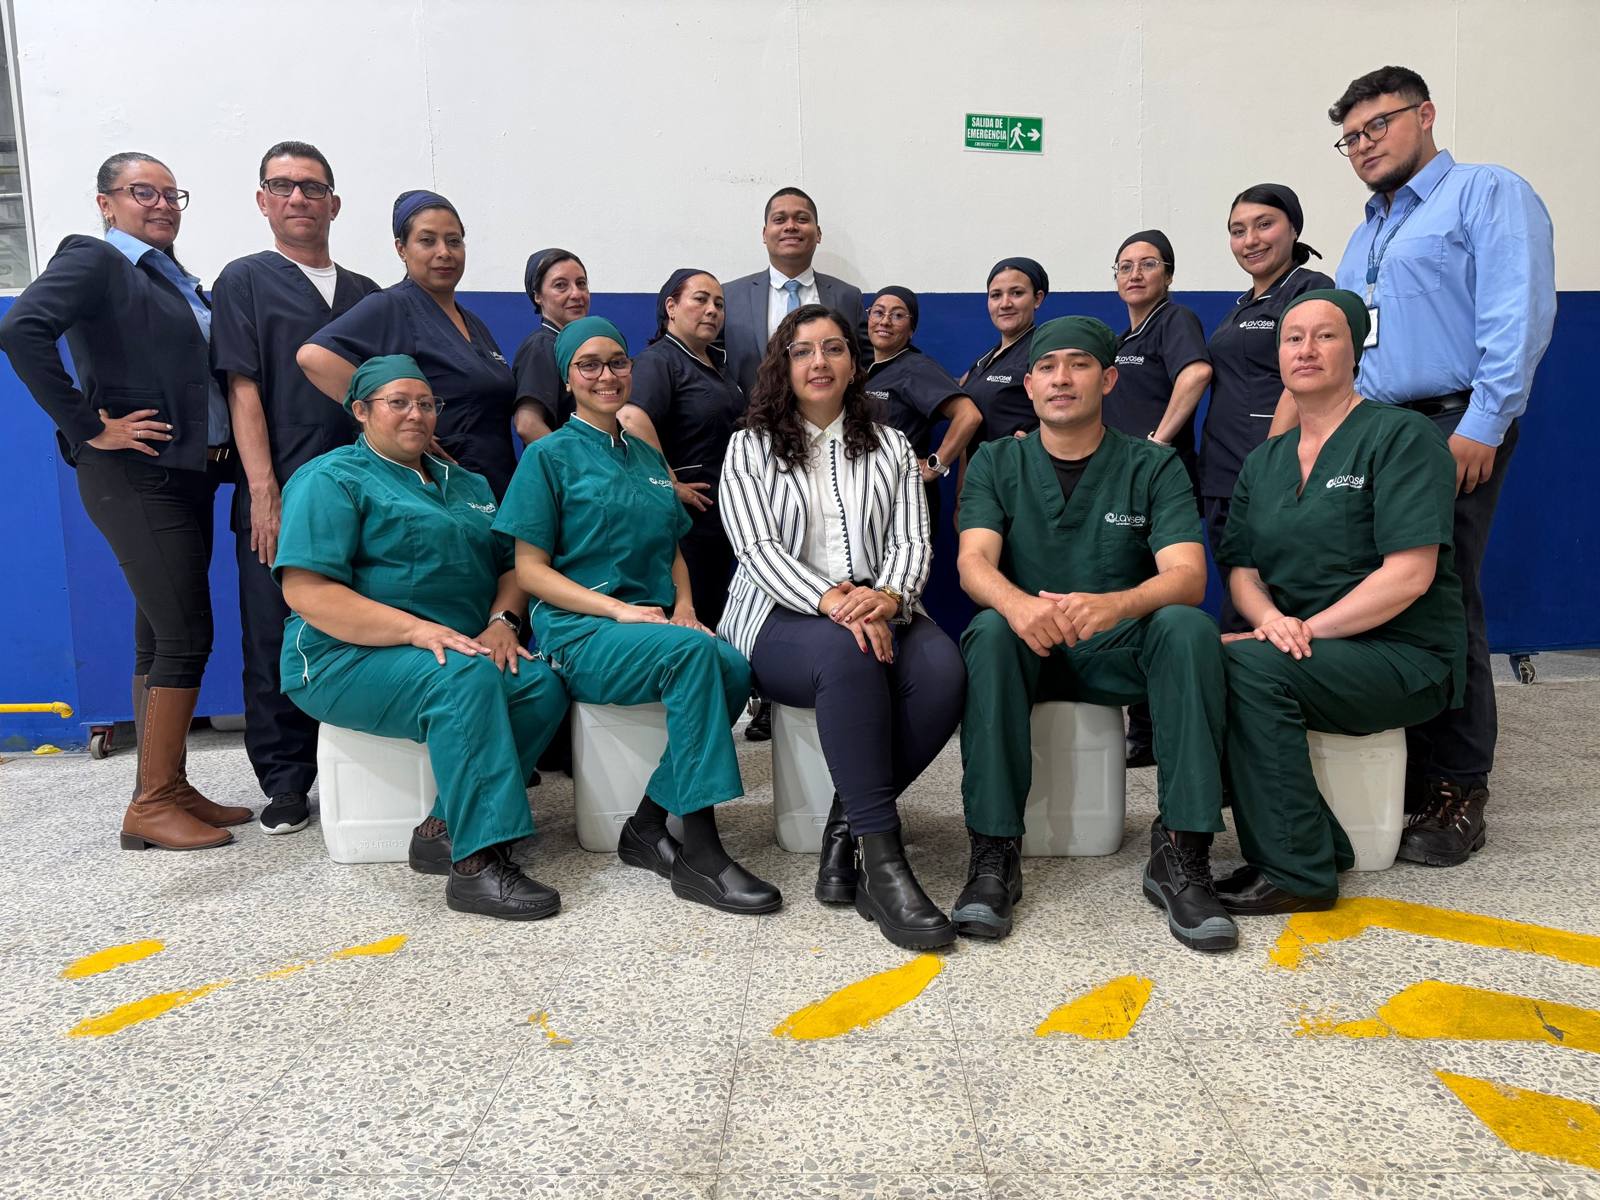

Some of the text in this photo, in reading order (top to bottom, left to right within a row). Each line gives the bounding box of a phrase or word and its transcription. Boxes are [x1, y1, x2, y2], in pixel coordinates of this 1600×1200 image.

[971, 117, 1003, 129] SALIDA DE
[967, 128, 1007, 140] EMERGENCIA
[371, 839, 405, 849] LITROS
